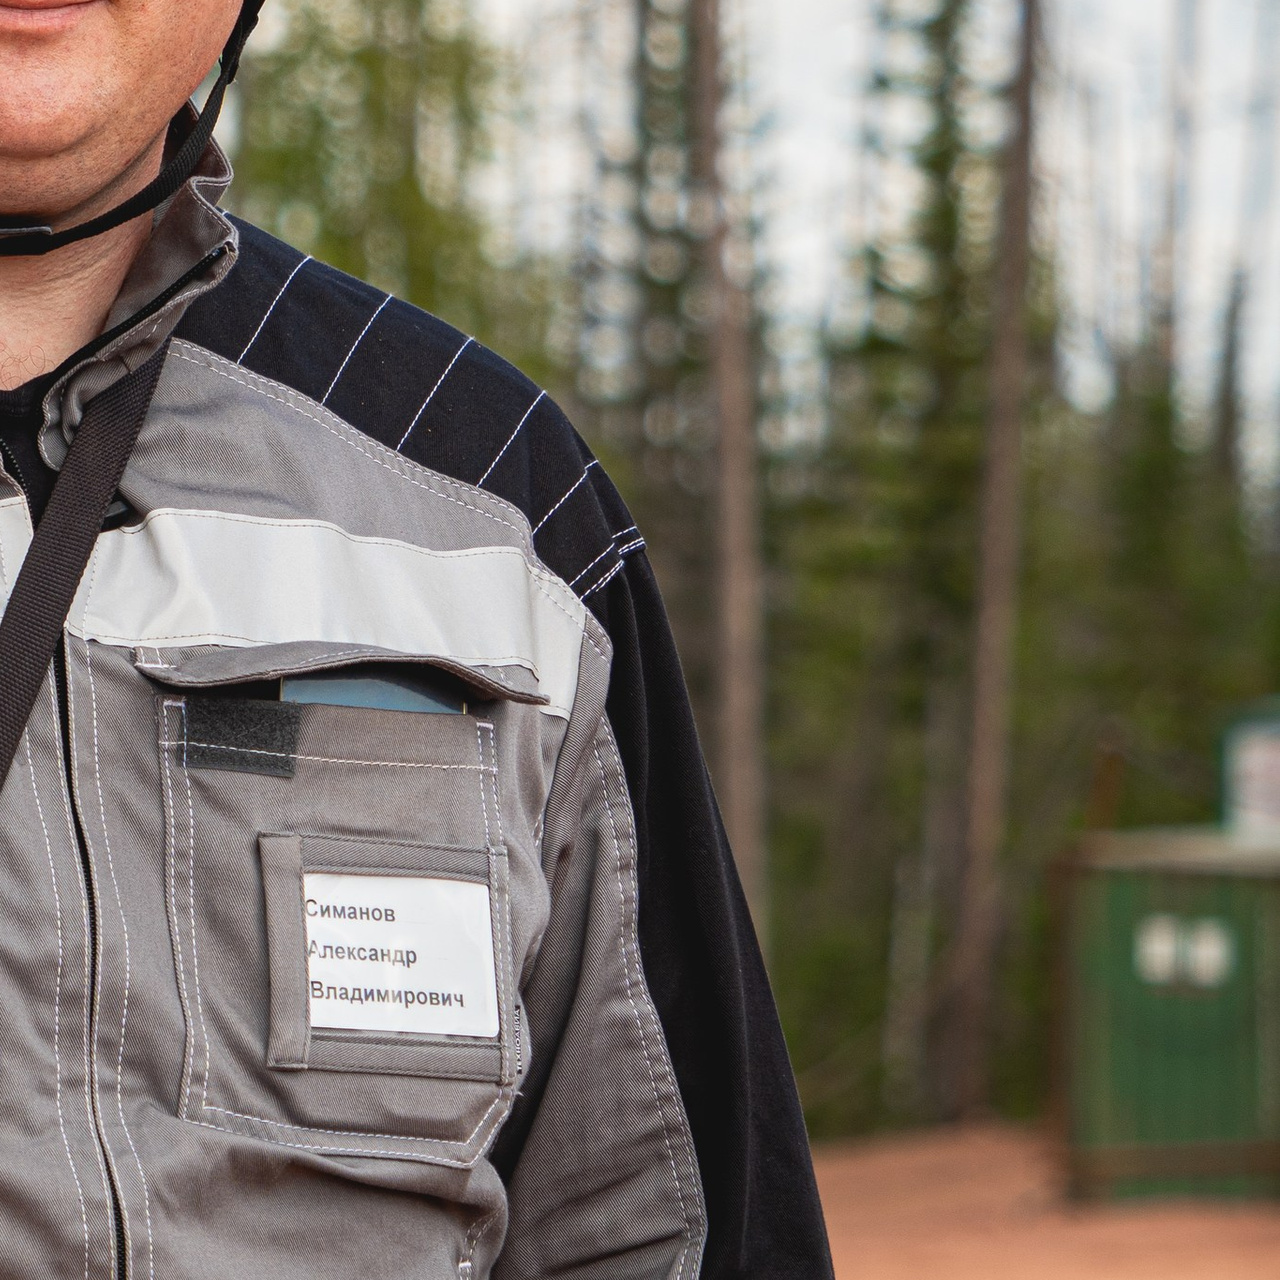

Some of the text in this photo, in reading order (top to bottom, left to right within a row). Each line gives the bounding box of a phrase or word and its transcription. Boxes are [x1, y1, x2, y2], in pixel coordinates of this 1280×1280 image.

[305, 899, 396, 922] Симанов
[308, 940, 417, 968] Александр
[311, 981, 465, 1009] Владимирович
